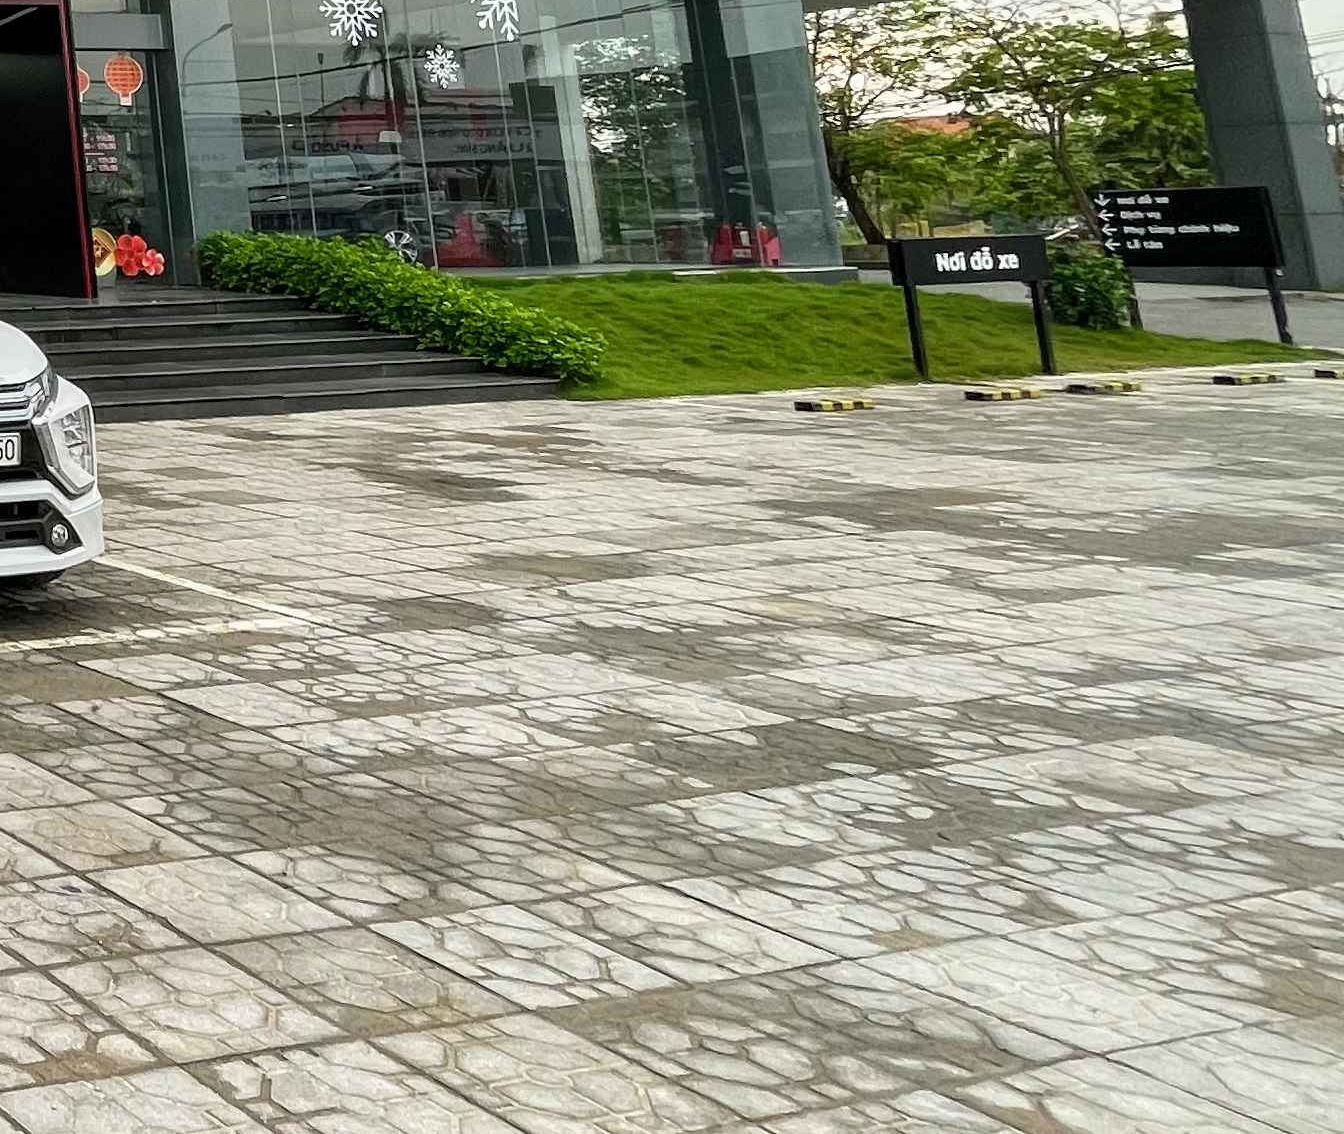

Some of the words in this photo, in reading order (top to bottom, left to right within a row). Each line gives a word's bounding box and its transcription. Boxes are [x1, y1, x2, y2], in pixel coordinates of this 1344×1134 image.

[935, 251, 967, 272] Nơi
[969, 246, 994, 271] đỗ
[997, 253, 1020, 270] xe
